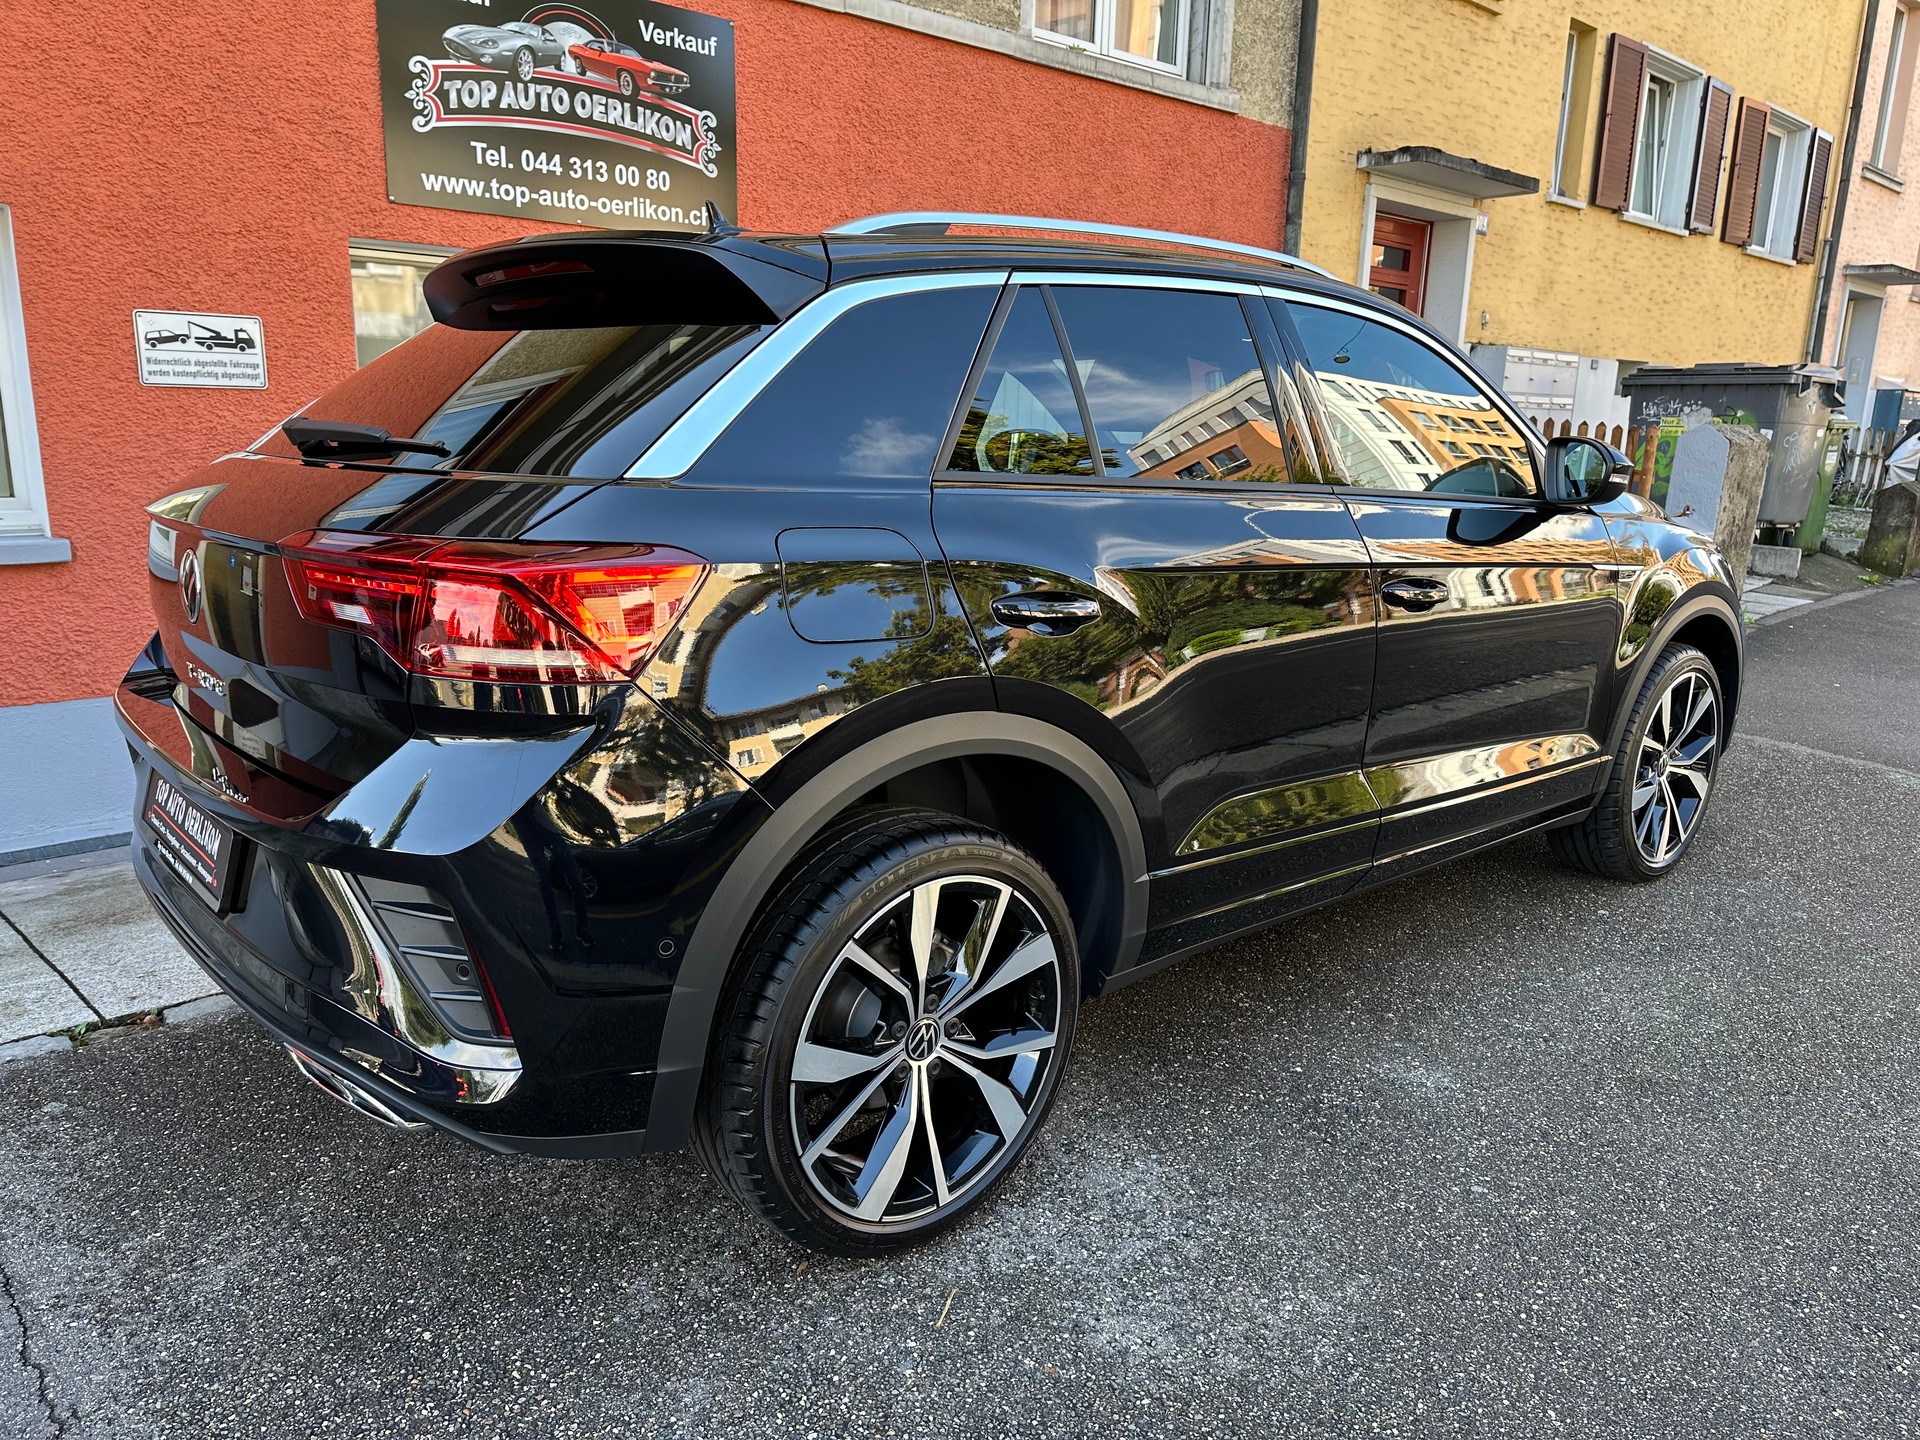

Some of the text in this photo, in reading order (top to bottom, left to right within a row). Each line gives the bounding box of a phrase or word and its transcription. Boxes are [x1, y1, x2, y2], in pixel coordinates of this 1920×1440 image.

[638, 19, 718, 57] Verkauf
[443, 80, 693, 150] TOP AUTO OERLIKON
[470, 141, 670, 192] Tel. 044 313 00 80
[421, 172, 709, 228] www.top-auto-oerlikon.ch
[146, 357, 260, 371] Widerrechtlich abgestellte Fahrzeuge
[147, 368, 261, 382] werden kostenpflichtig abgeschleppt
[155, 779, 170, 806] TOP
[166, 788, 186, 825] AUTO
[184, 806, 222, 861] OERLIKON
[859, 847, 966, 902] POTENZA
